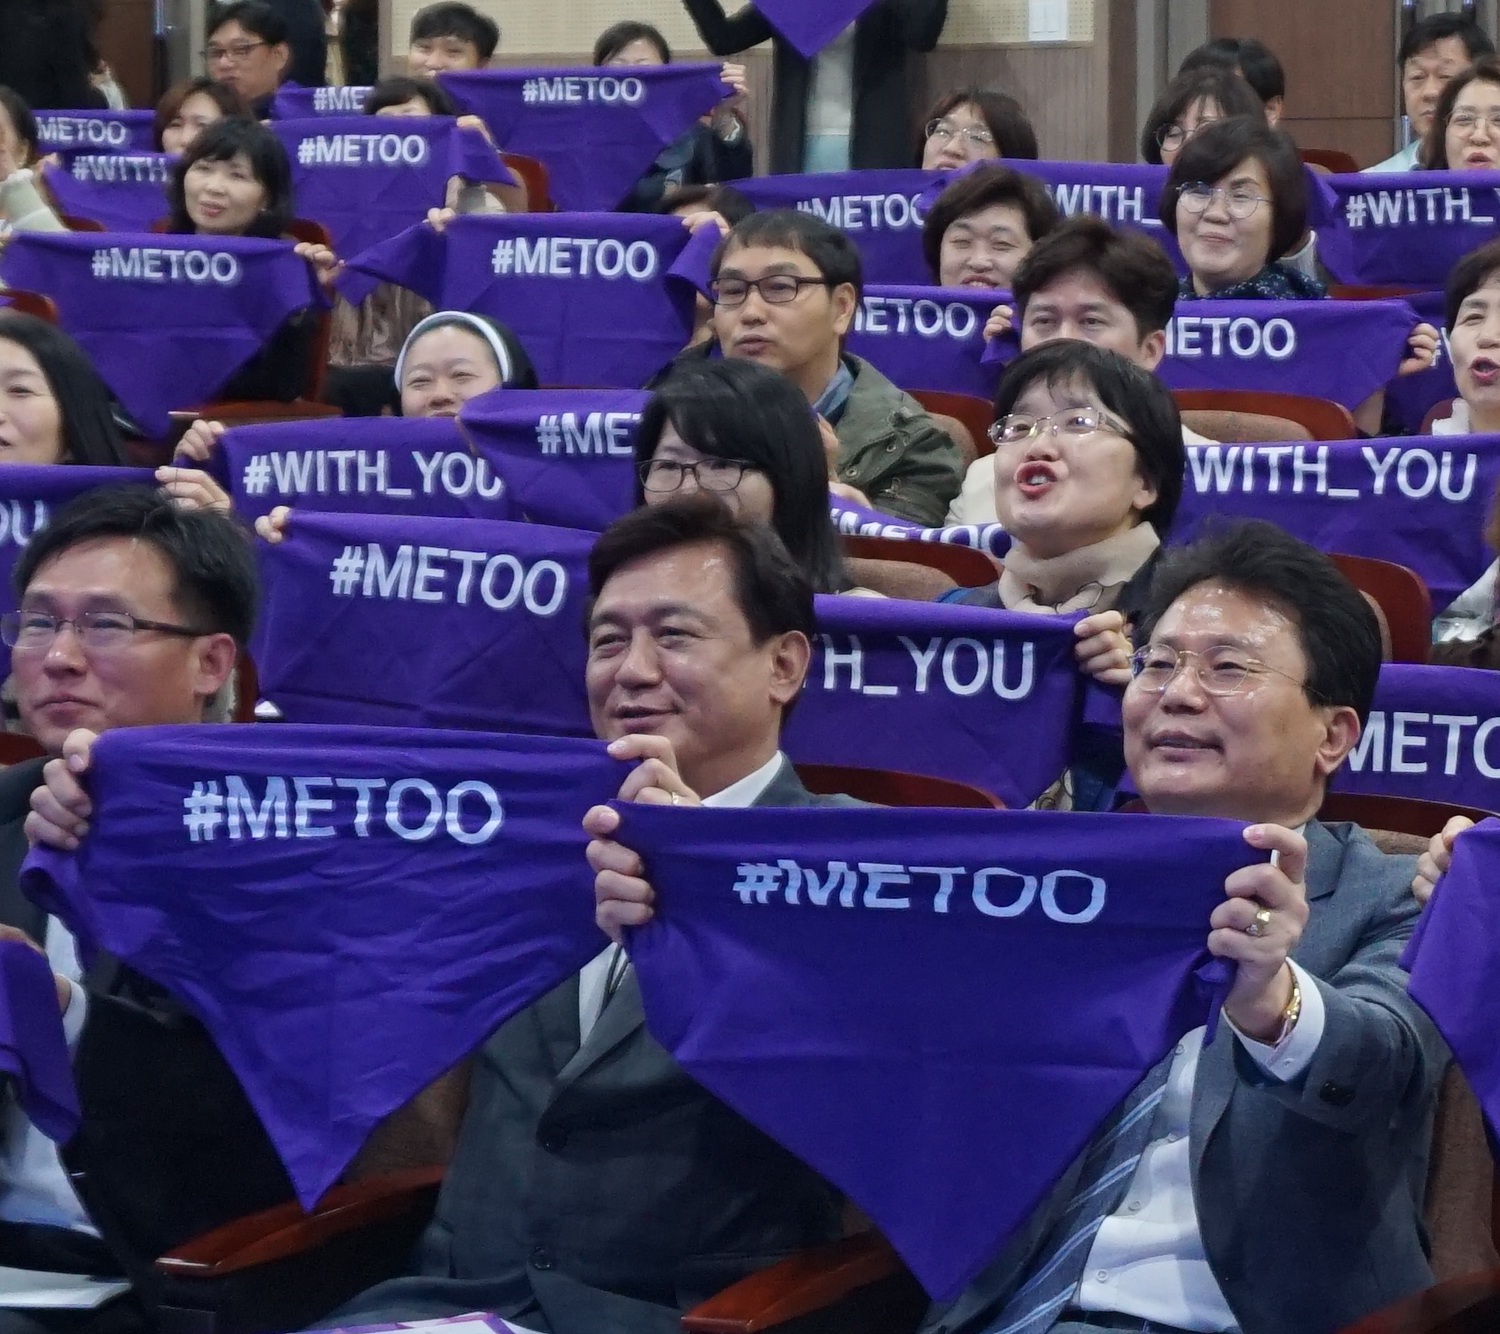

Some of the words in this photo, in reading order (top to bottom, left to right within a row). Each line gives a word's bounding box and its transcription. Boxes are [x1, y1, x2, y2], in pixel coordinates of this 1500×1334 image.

[315, 87, 373, 109] #ME
[523, 78, 642, 101] #METOO
[36, 117, 126, 144] METOO
[298, 135, 424, 163] #METOO
[74, 156, 167, 181] #WITH
[1057, 184, 1162, 224] WITH_
[92, 248, 237, 281] #METOO
[492, 238, 655, 278] #METOO
[855, 297, 975, 337] ETOO
[1166, 317, 1294, 357] ETOO
[534, 412, 641, 454] #ME
[1185, 445, 1477, 500] WITH_YOU
[330, 544, 566, 615] #METOO
[805, 634, 1034, 699] H_YOU
[183, 776, 502, 844] #METOO
[733, 860, 1106, 923] #METOO
